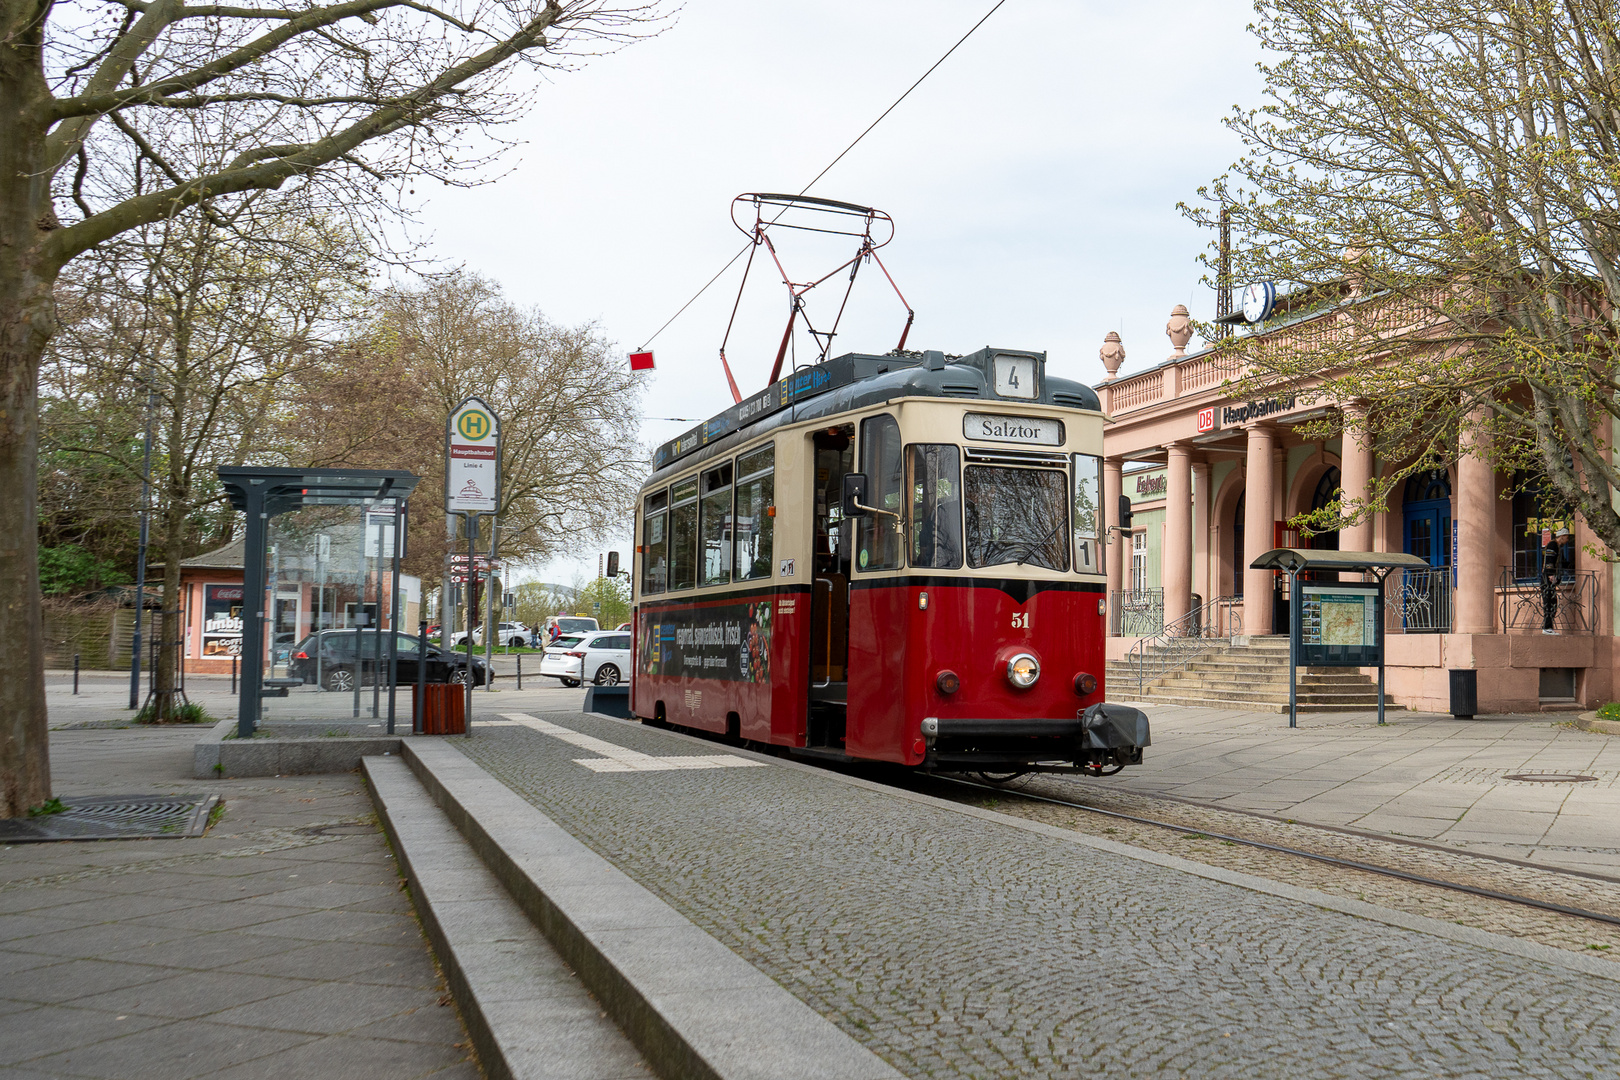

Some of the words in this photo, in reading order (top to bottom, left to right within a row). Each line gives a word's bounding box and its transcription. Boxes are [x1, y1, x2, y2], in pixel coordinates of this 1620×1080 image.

[1008, 365, 1020, 390] 4
[466, 416, 482, 434] H
[1199, 410, 1212, 429] DB
[981, 420, 1042, 439] Salztor
[452, 448, 495, 458] Hauptbahnhof
[1079, 540, 1090, 566] 1
[1011, 612, 1030, 629] 51
[676, 623, 694, 650] regional,
[694, 622, 724, 650] sympathisch,
[725, 620, 741, 645] frisch
